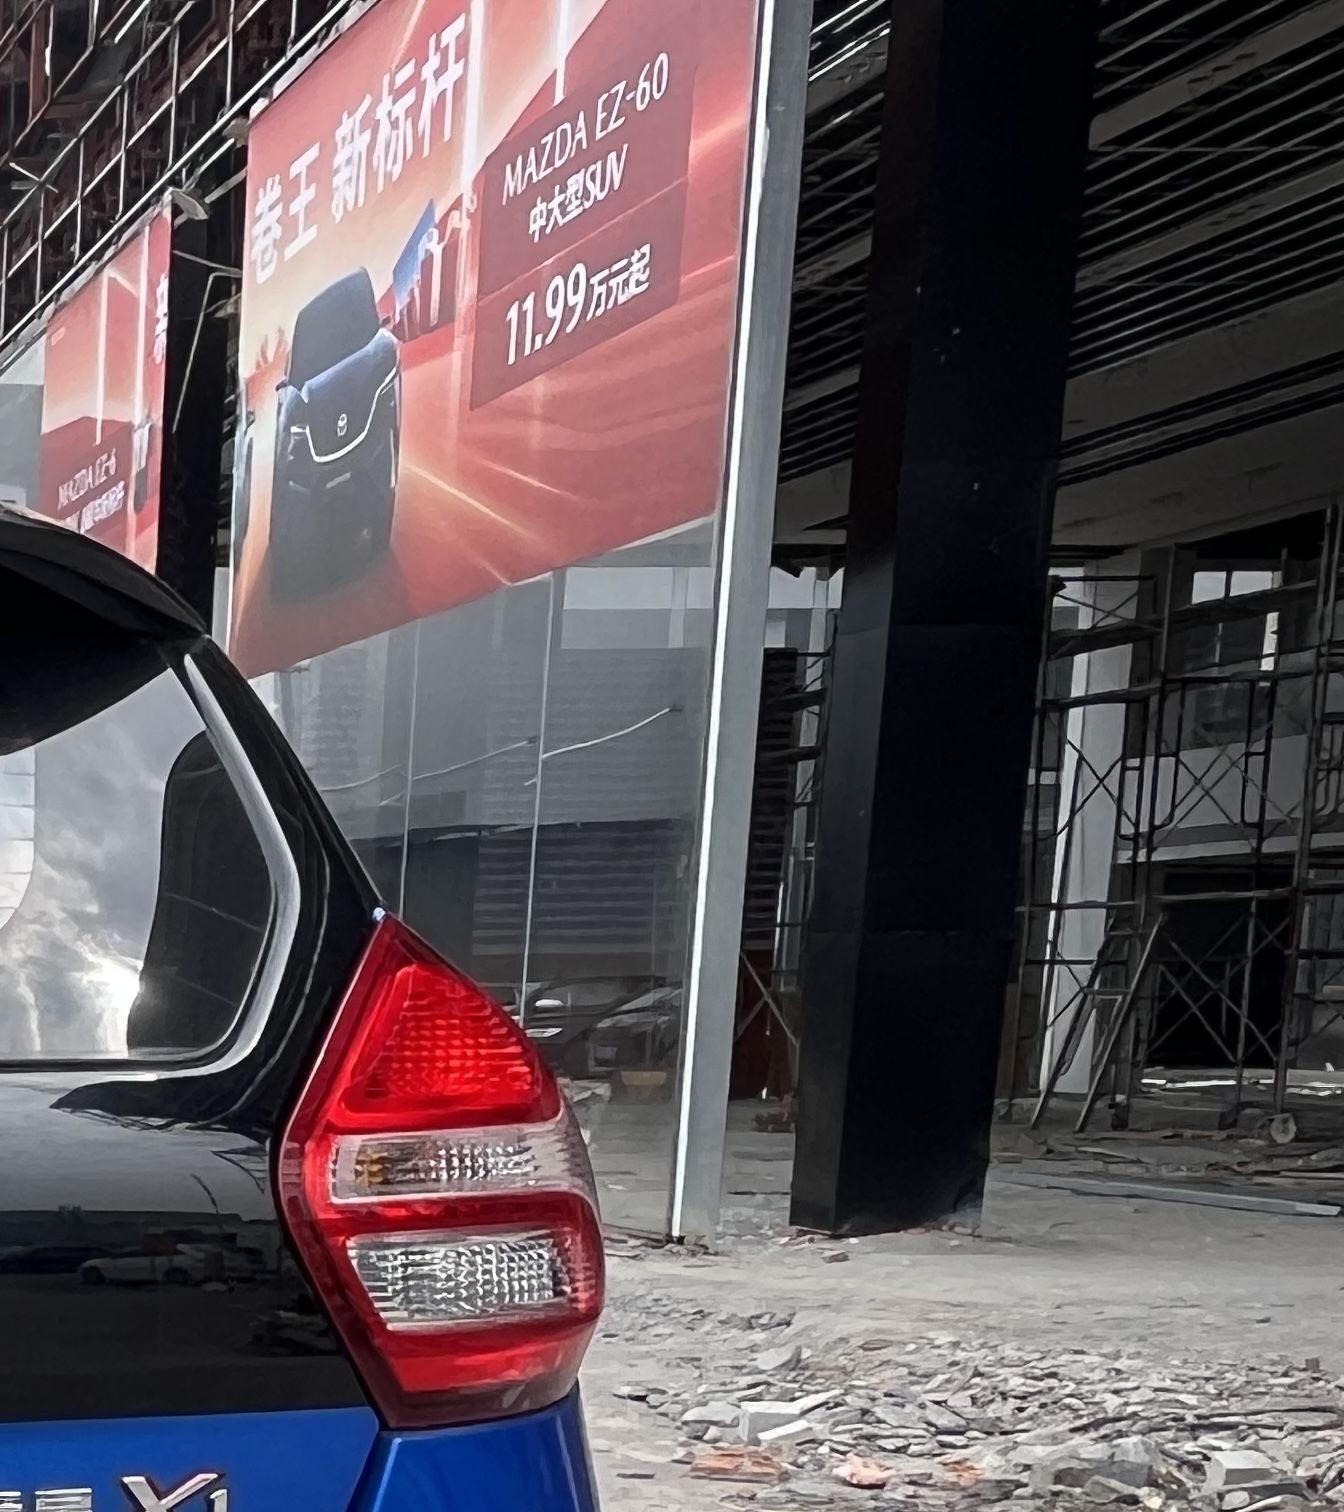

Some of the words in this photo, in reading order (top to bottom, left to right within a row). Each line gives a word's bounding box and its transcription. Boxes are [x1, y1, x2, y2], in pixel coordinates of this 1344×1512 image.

[251, 141, 320, 284] 卷王
[332, 12, 466, 224] 新标杆
[502, 110, 588, 206] MAZDA
[595, 52, 669, 141] EZ-60
[529, 143, 629, 243] 中大型SUV
[505, 243, 651, 365] 11.99万元起
